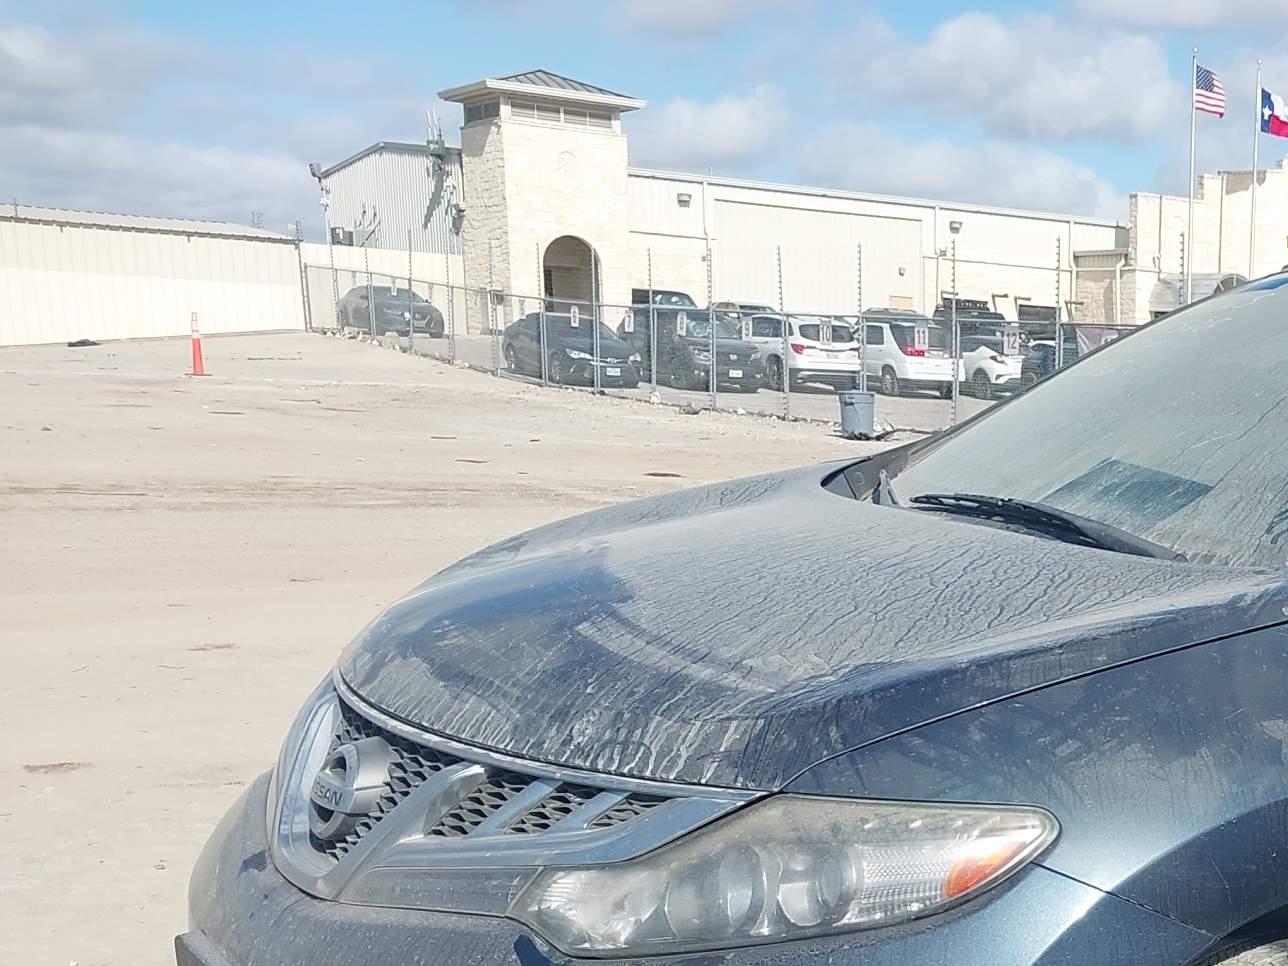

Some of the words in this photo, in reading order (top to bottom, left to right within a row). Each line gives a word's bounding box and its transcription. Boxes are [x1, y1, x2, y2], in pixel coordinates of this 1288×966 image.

[820, 323, 832, 342] 10
[916, 329, 927, 345] 11
[1006, 332, 1018, 350] 12
